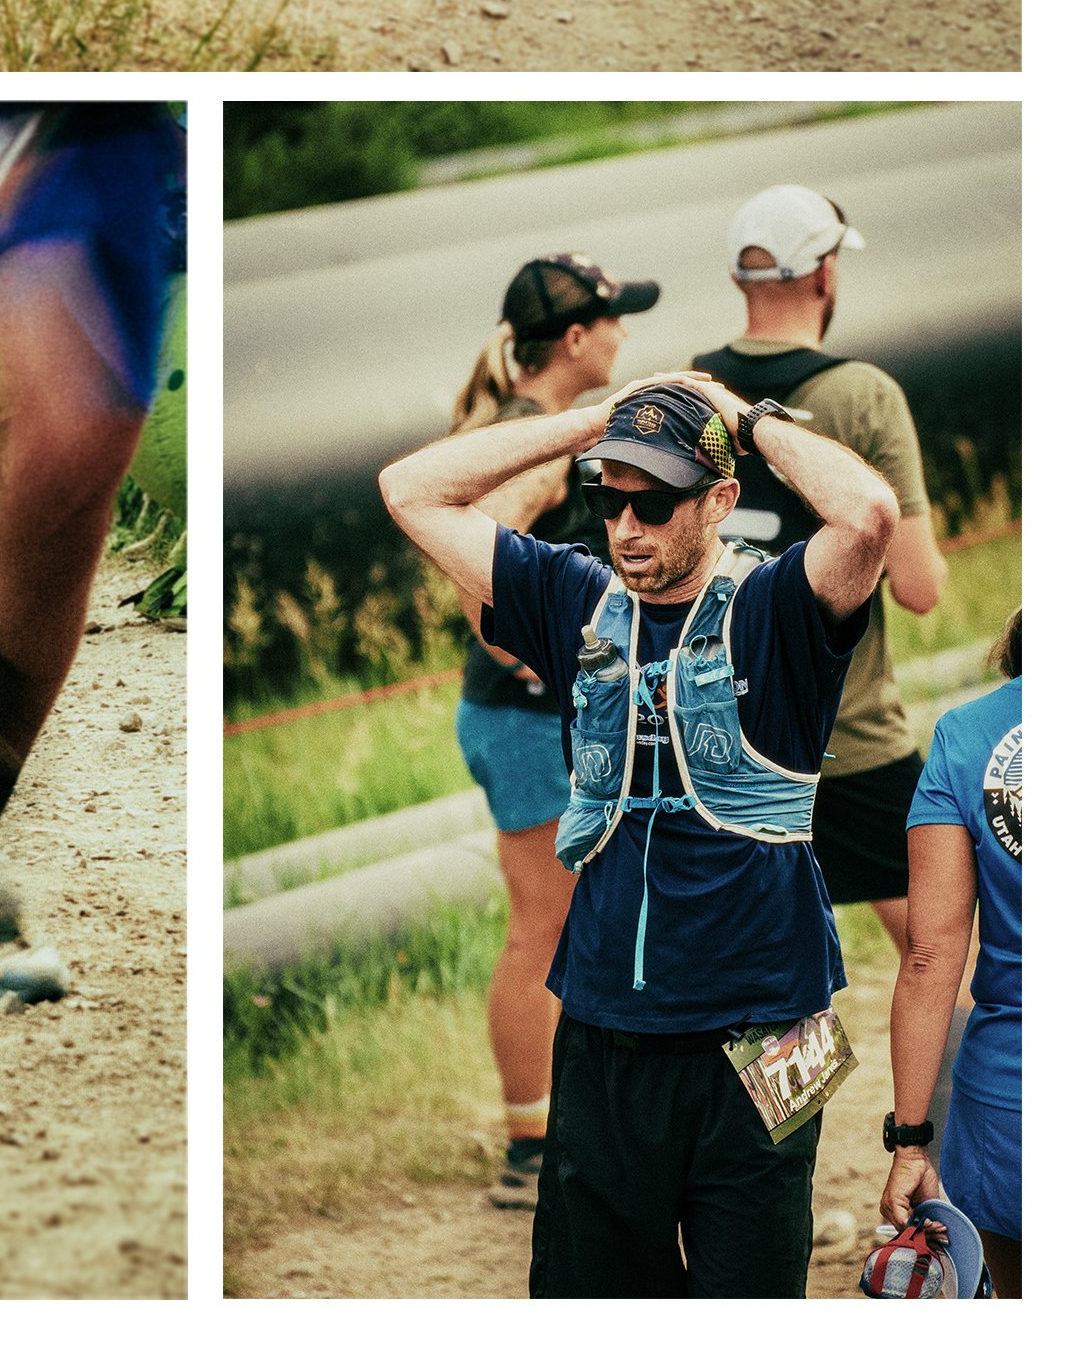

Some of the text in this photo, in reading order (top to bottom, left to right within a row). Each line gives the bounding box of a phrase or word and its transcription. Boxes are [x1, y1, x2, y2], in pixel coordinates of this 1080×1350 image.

[992, 815, 1023, 856] UTAH
[764, 1016, 836, 1101] 7144
[788, 1078, 822, 1112] Andrew
